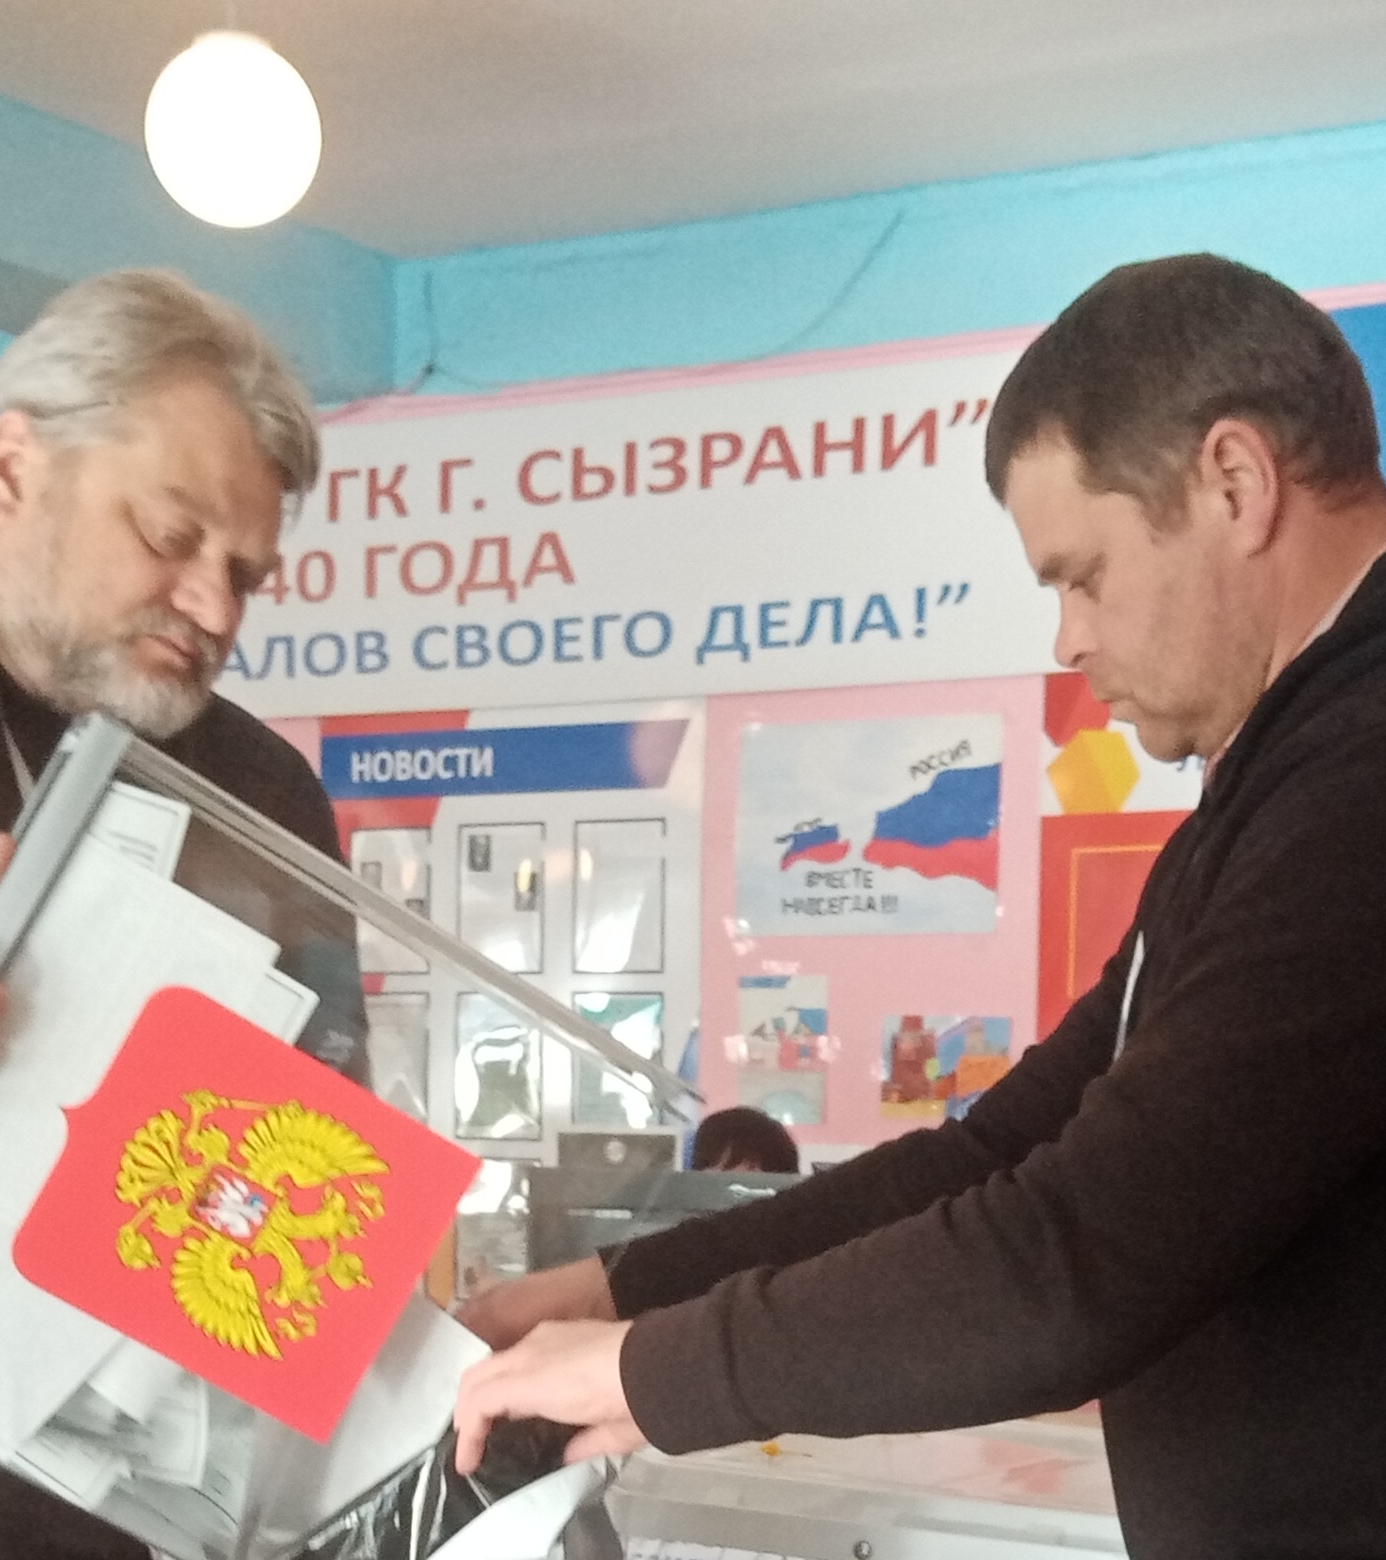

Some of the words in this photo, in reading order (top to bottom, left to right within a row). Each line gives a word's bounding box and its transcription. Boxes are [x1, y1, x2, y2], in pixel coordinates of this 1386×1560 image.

[437, 457, 486, 515] Г.
[363, 530, 576, 605] ГОДА
[224, 630, 390, 681] АЛОВ
[412, 608, 674, 674] СВОЕГО
[351, 746, 495, 785] НОВОСТИ
